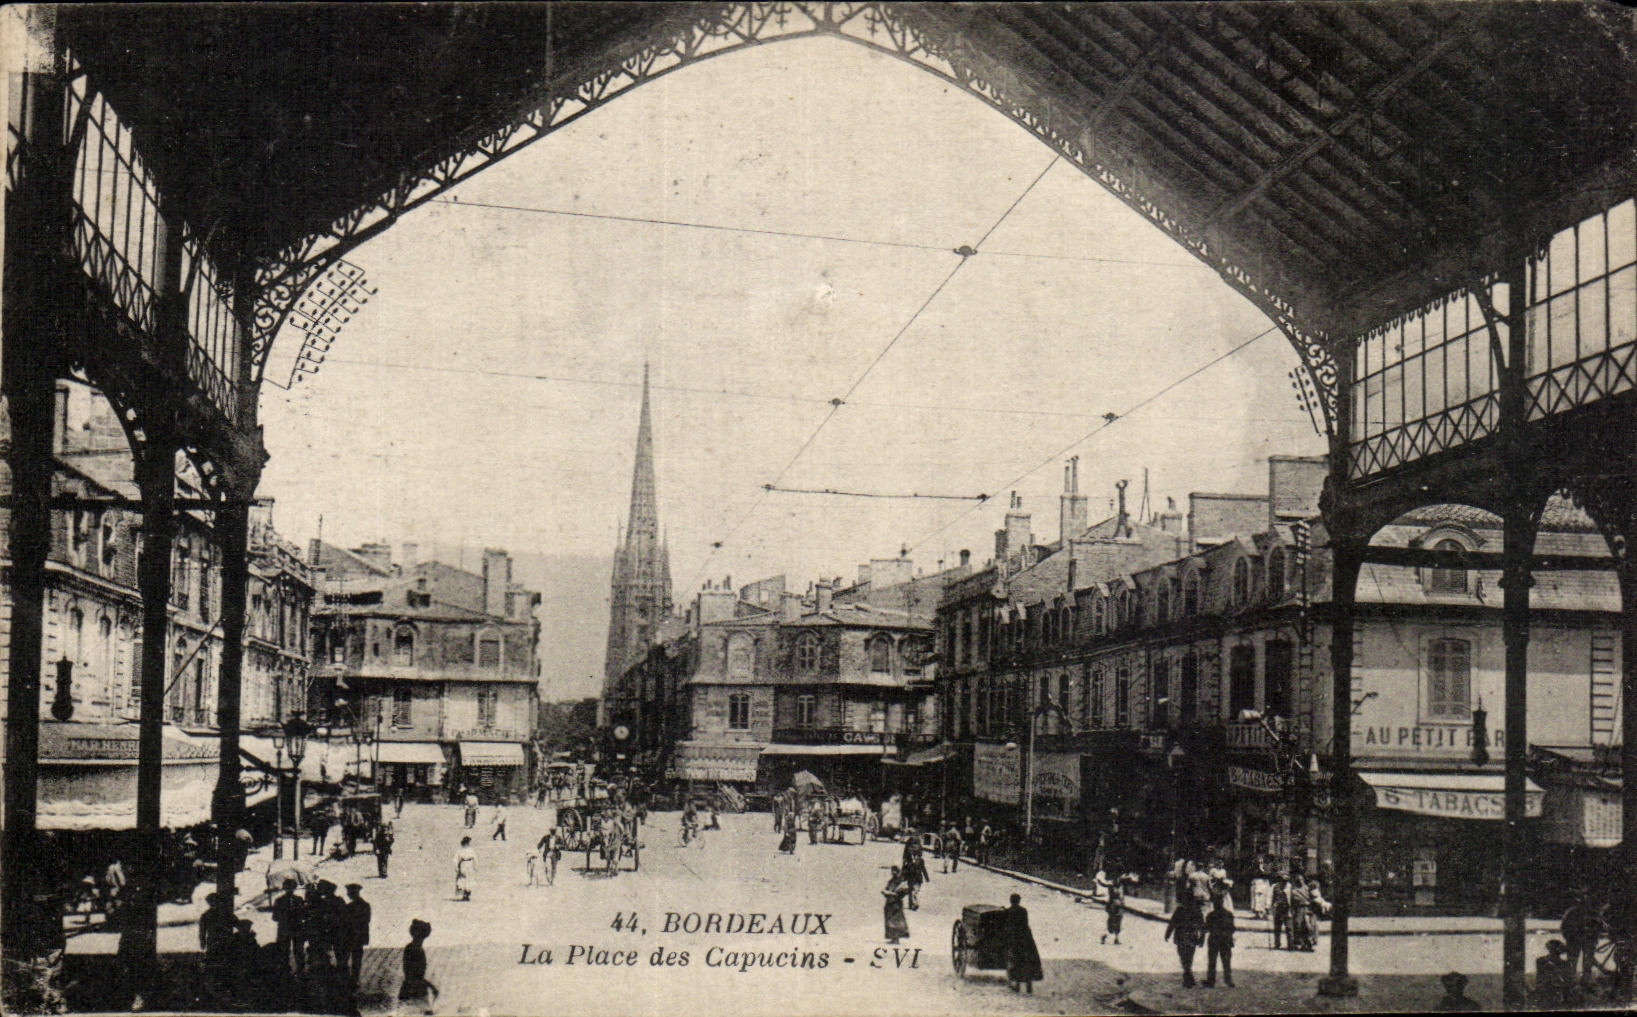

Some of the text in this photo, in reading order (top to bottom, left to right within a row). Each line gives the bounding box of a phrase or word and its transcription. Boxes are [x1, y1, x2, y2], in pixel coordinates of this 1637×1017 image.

[1366, 727, 1391, 745] AU
[1397, 728, 1457, 747] PETIT
[1416, 790, 1506, 817] TABACS
